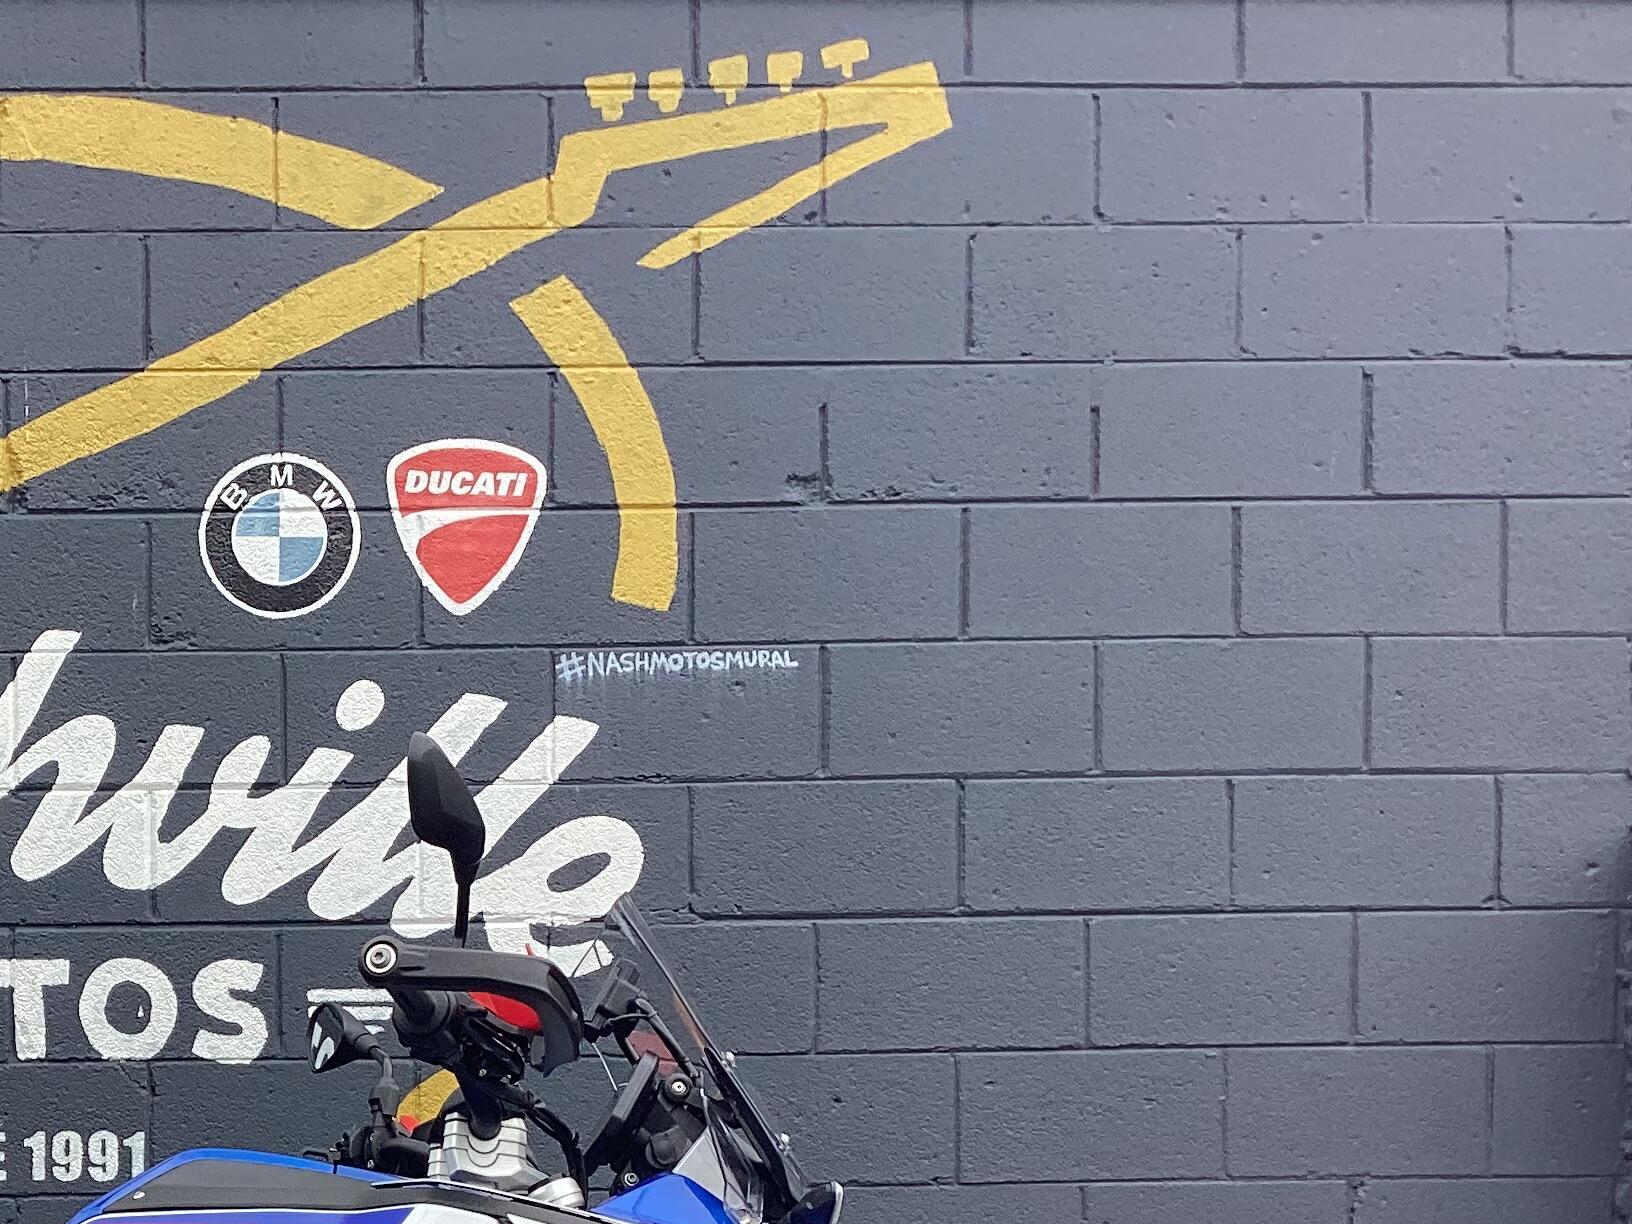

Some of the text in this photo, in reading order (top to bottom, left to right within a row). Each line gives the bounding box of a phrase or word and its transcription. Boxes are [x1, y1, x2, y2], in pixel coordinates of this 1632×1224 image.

[220, 463, 344, 513] BMW
[404, 469, 528, 498] DUCATI
[555, 650, 799, 682] #NASHMOTOSMURAL
[23, 1130, 146, 1182] 1991
